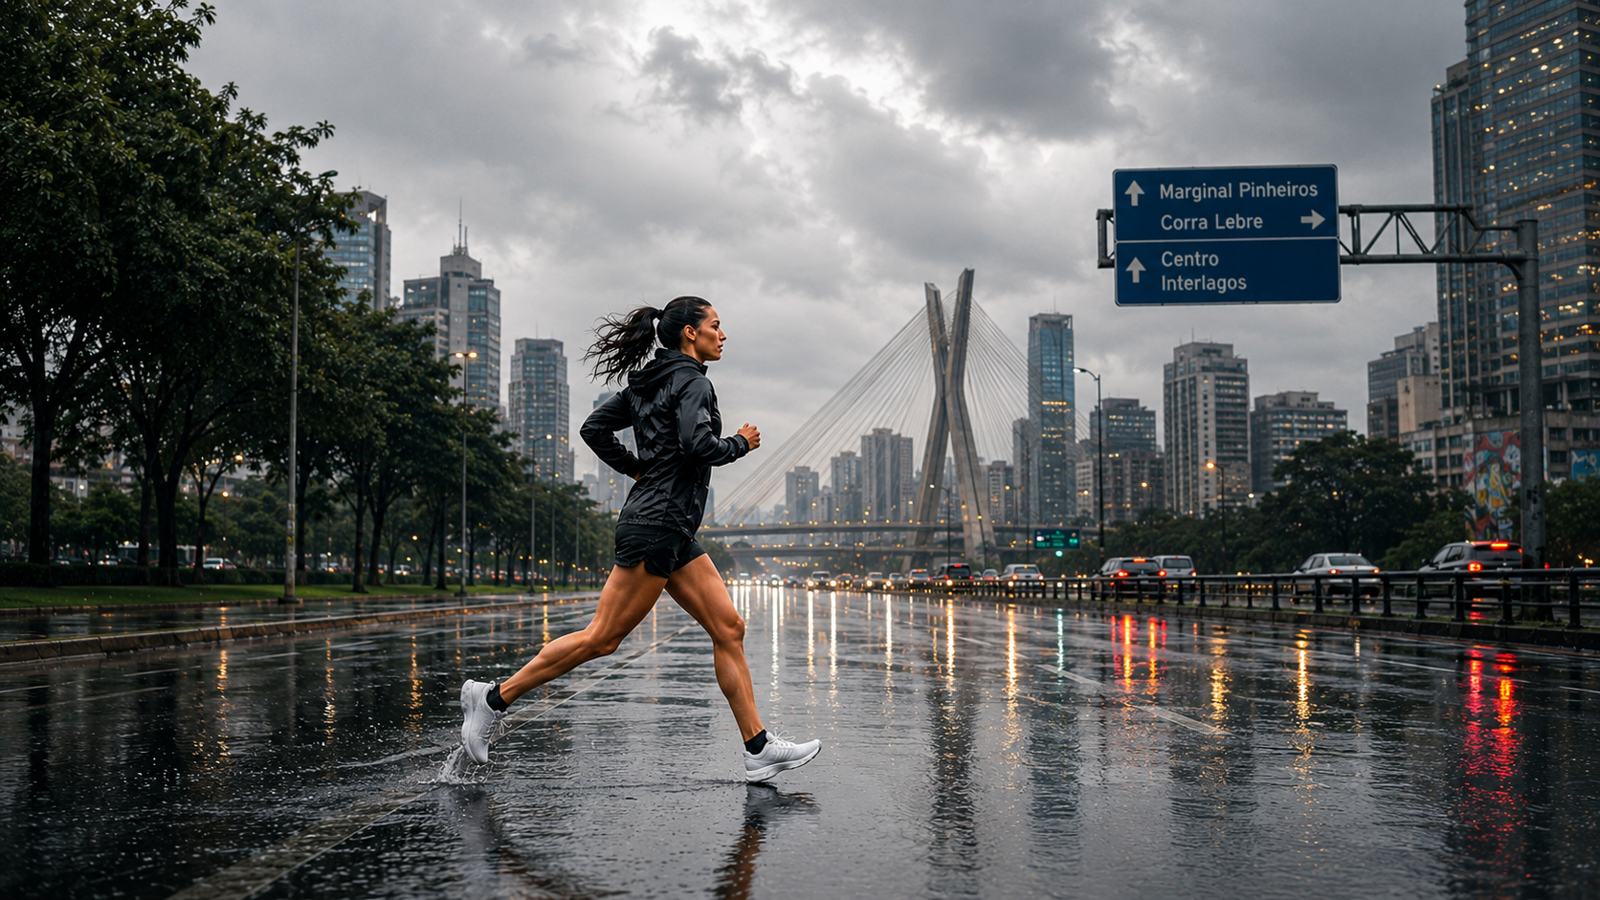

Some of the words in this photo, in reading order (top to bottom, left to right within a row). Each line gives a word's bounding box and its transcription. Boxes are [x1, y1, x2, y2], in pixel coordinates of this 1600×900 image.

[1160, 182, 1232, 203] Marginal
[1239, 181, 1318, 198] Pinheiros
[1161, 214, 1208, 231] Corra
[1215, 213, 1263, 230] Lebre
[1161, 251, 1219, 267] Centro
[1161, 274, 1247, 294] Interlagos
